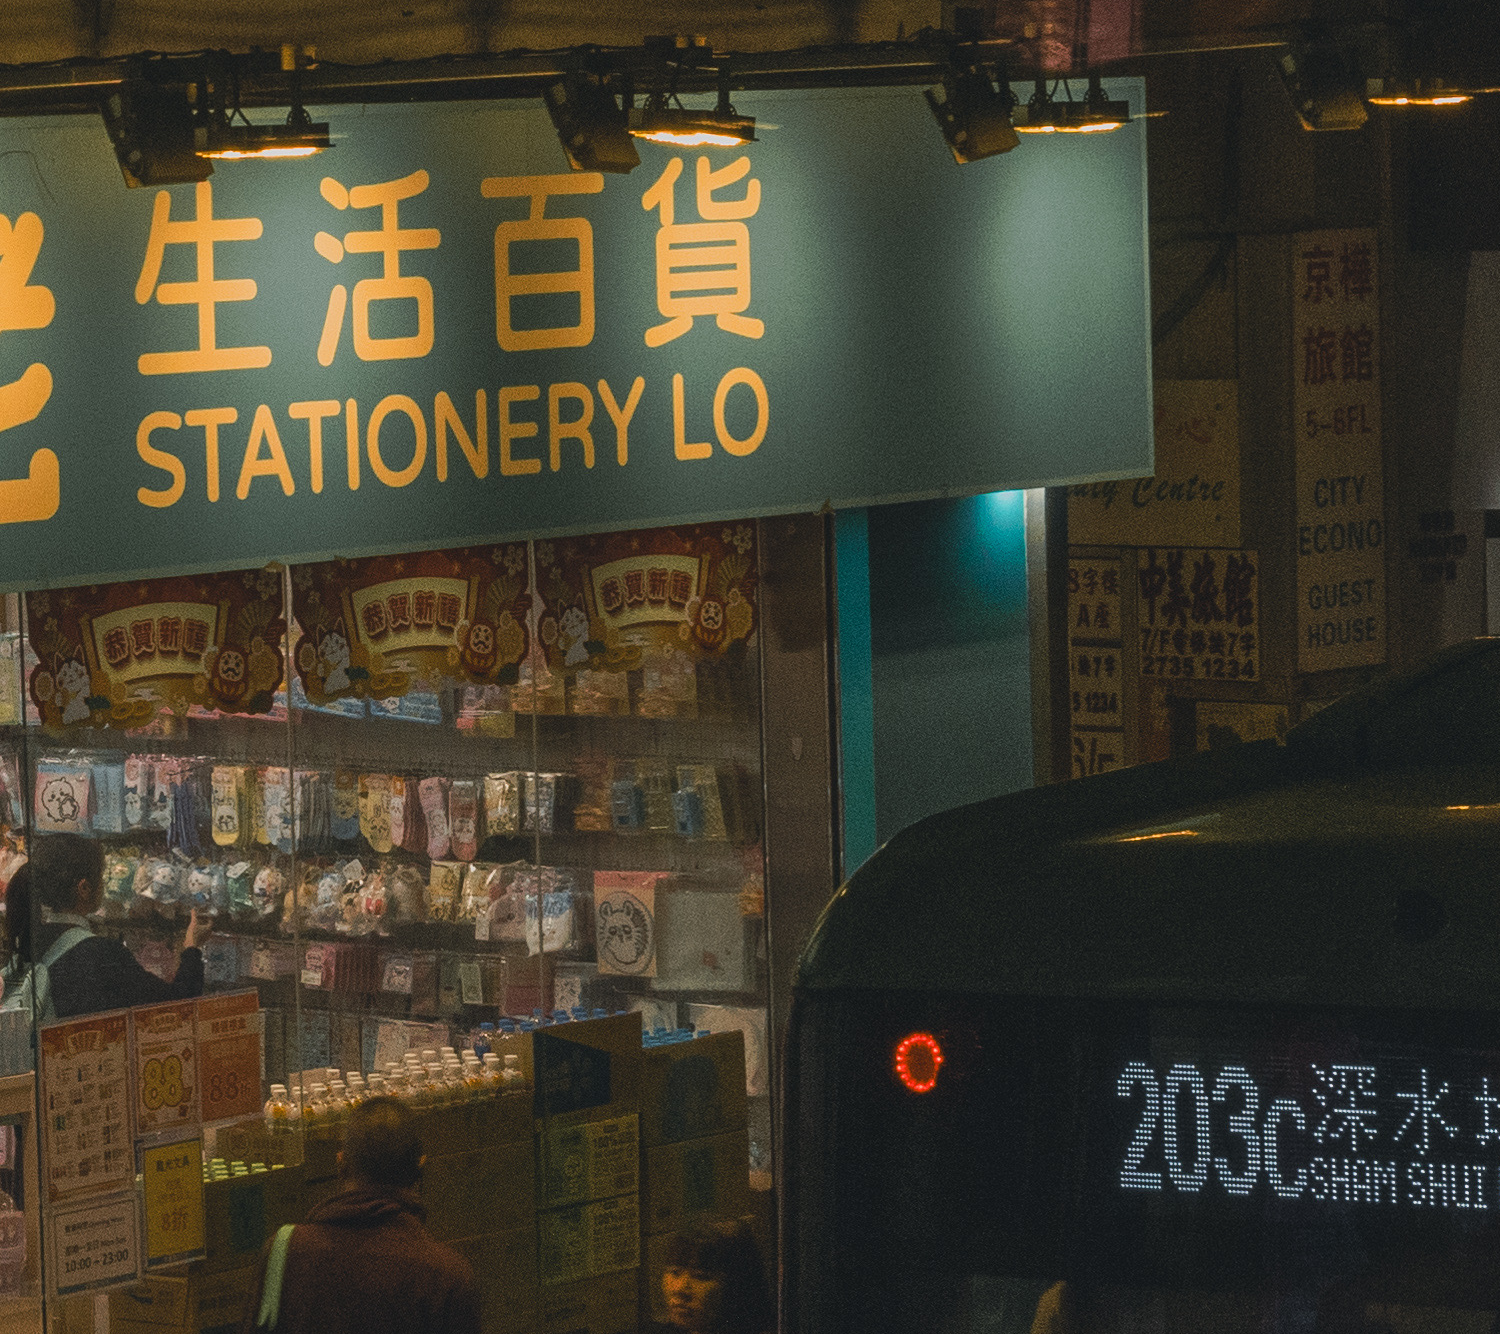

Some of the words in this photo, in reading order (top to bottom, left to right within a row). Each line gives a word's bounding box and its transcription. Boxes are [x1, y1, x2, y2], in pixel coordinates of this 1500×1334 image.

[137, 155, 764, 377] 生活百貨
[1302, 324, 1374, 386] 旅館
[135, 374, 646, 509] STATIONERY
[670, 367, 770, 461] LO
[1132, 474, 1224, 507] Centre
[1313, 475, 1366, 508] CITY
[1300, 519, 1382, 556] ECONO
[602, 567, 692, 612] 恭賀新禧
[1308, 579, 1375, 610] GUEST
[363, 590, 464, 634] 恭賀新禧
[1307, 619, 1376, 649] HOUSE
[103, 616, 212, 665] 恭賀新禧
[1143, 656, 1194, 676] 2735
[1202, 659, 1255, 679] 1234
[142, 1056, 182, 1110] 88
[1310, 1156, 1397, 1204] SHAM
[1408, 1162, 1487, 1210] SHUI
